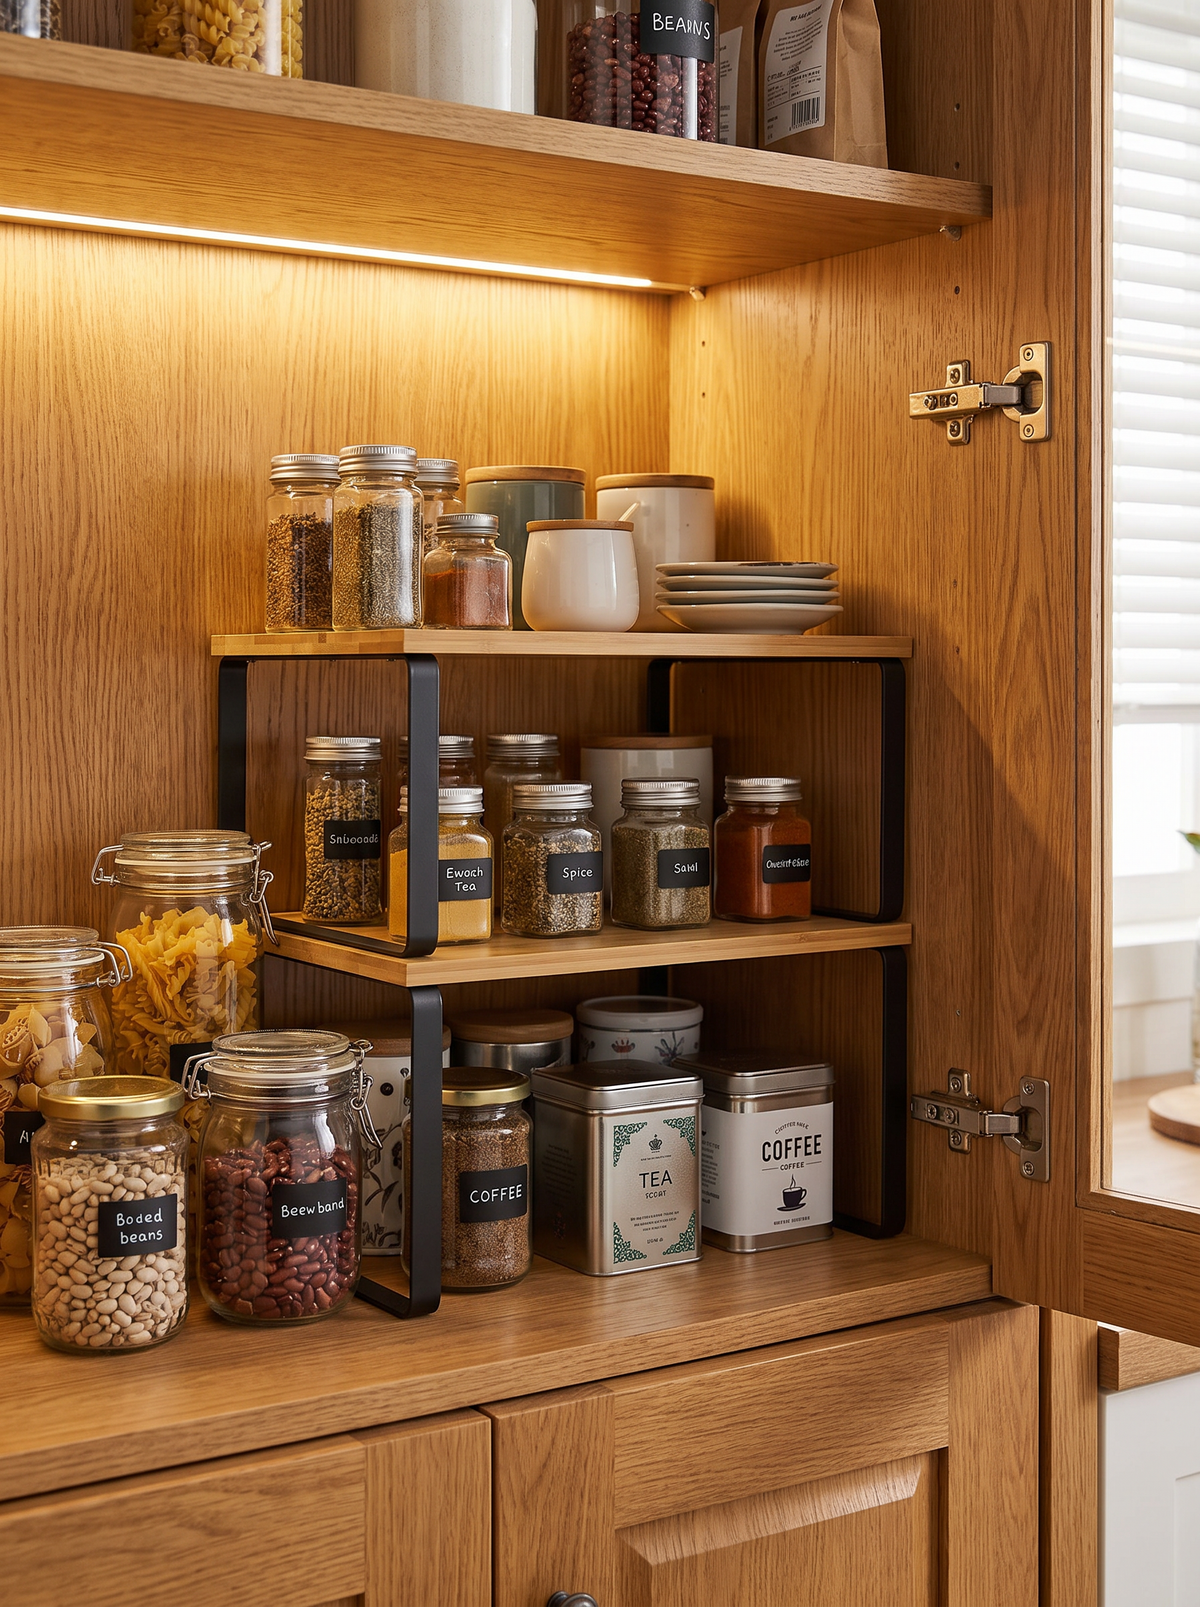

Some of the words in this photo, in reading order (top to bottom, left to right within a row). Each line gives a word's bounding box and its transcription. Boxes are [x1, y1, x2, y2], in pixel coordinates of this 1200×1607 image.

[562, 867, 594, 881] Spice
[455, 882, 477, 892] Tea
[761, 1134, 822, 1162] COFFEE
[780, 1161, 805, 1171] COFFEE
[638, 1169, 673, 1189] TEA
[469, 1184, 523, 1204] COFFEE
[317, 1197, 345, 1215] band
[120, 1228, 163, 1245] beans
